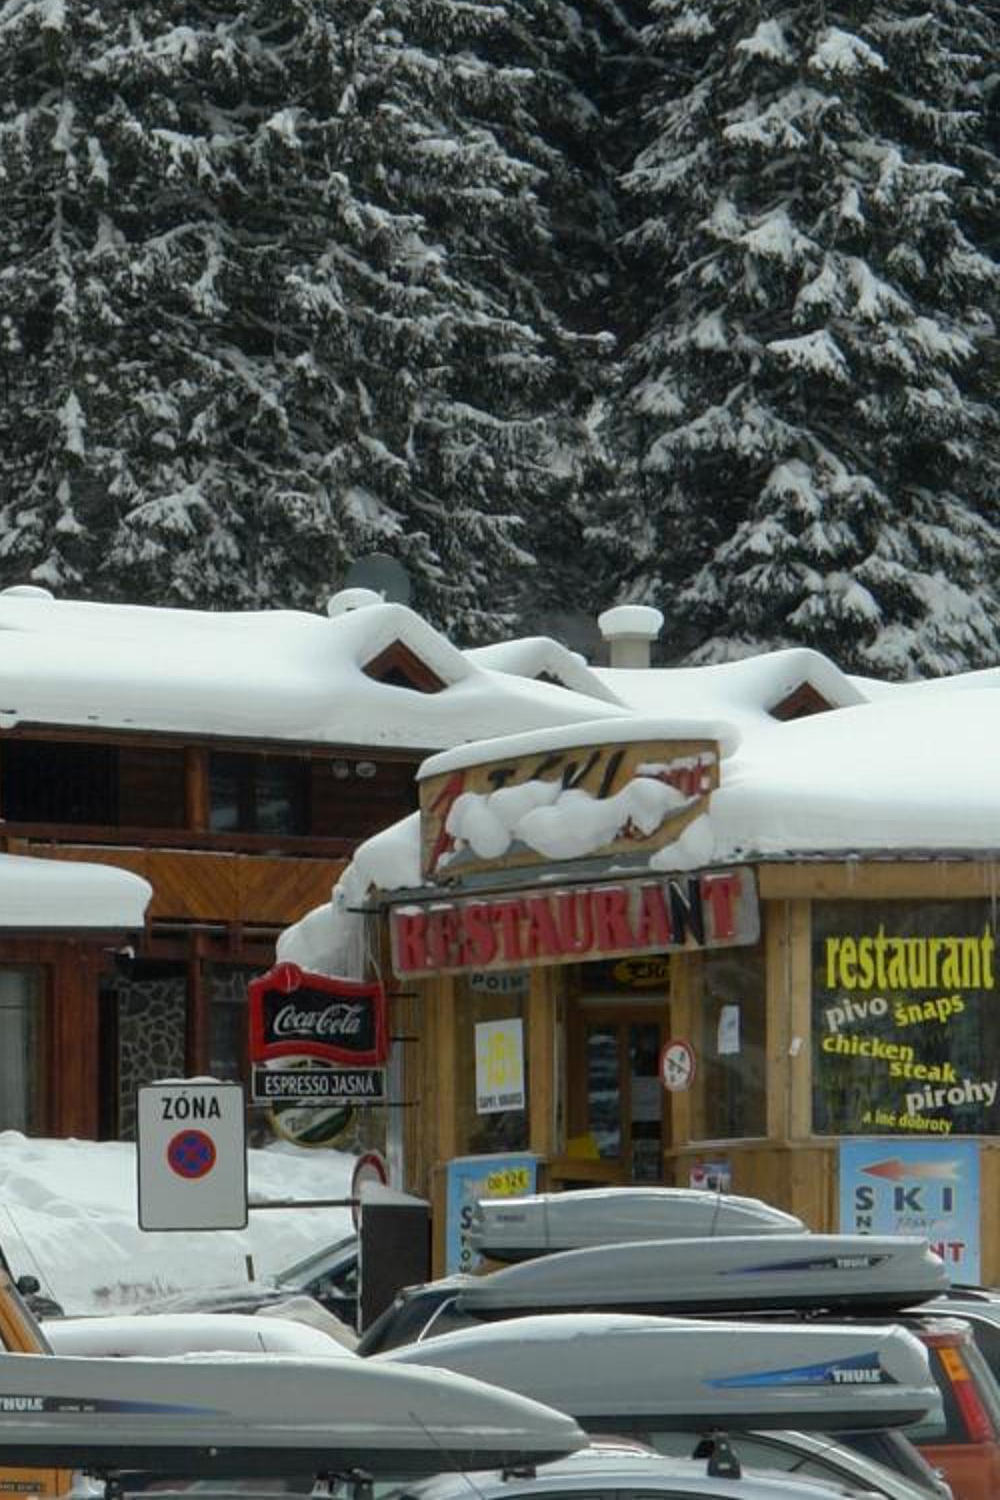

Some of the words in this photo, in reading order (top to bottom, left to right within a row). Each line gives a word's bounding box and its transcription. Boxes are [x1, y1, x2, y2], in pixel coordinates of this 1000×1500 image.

[395, 874, 740, 972] RESTAURANT
[825, 922, 994, 989] restaurant
[273, 1004, 364, 1036] Coca-Cola
[825, 997, 888, 1032] pivo
[894, 994, 965, 1027] šnaps
[822, 1034, 914, 1061] chicken
[265, 1075, 328, 1094] ESPRESSO
[889, 1060, 956, 1083] steak
[161, 1090, 221, 1120] ZÓNA
[905, 1078, 998, 1116] pirohy
[833, 1368, 881, 1384] THULE
